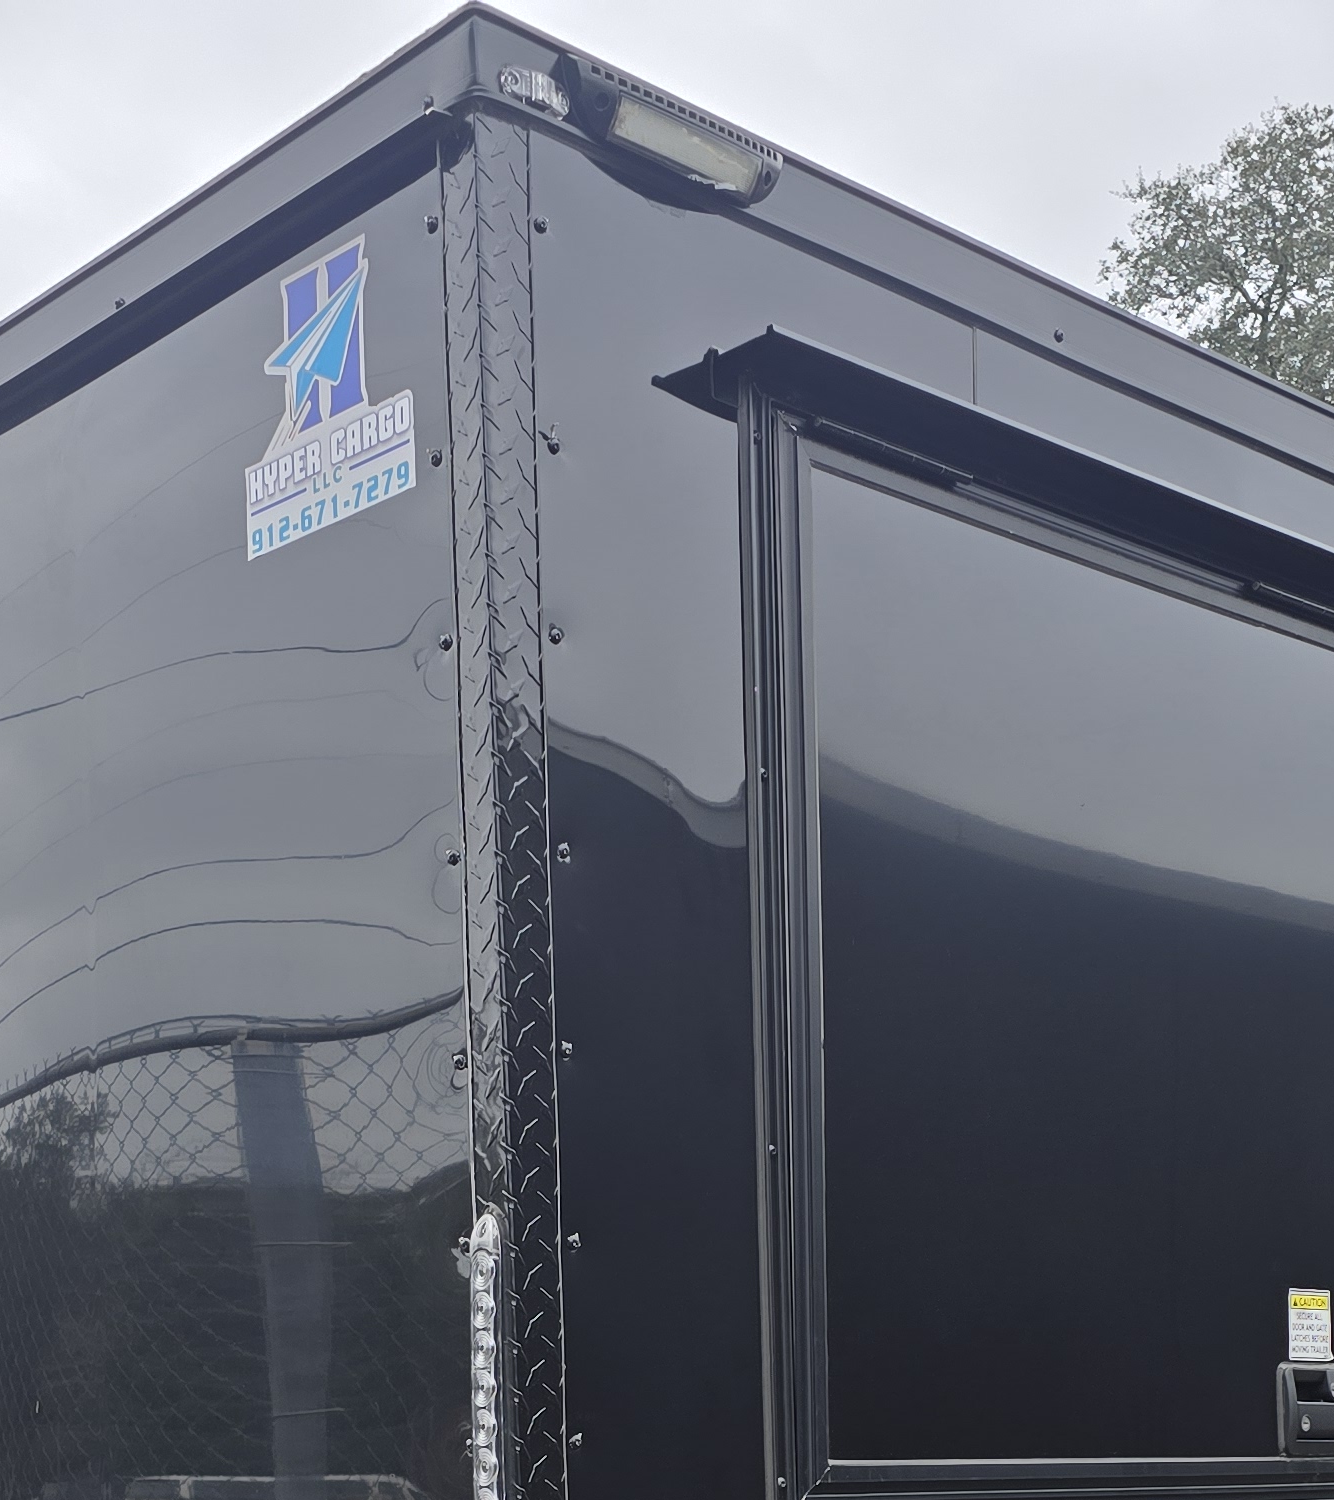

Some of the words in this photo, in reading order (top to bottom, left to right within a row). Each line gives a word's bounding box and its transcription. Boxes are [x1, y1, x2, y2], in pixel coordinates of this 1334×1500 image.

[248, 440, 322, 505] HYPER
[330, 396, 412, 465] CARGO
[312, 467, 344, 495] LLC
[251, 460, 410, 555] 912-671-7279
[1298, 1297, 1327, 1307] CAUTION
[1296, 1312, 1314, 1320] SECURE
[1292, 1322, 1305, 1331] DOOR
[1305, 1323, 1315, 1331] AND
